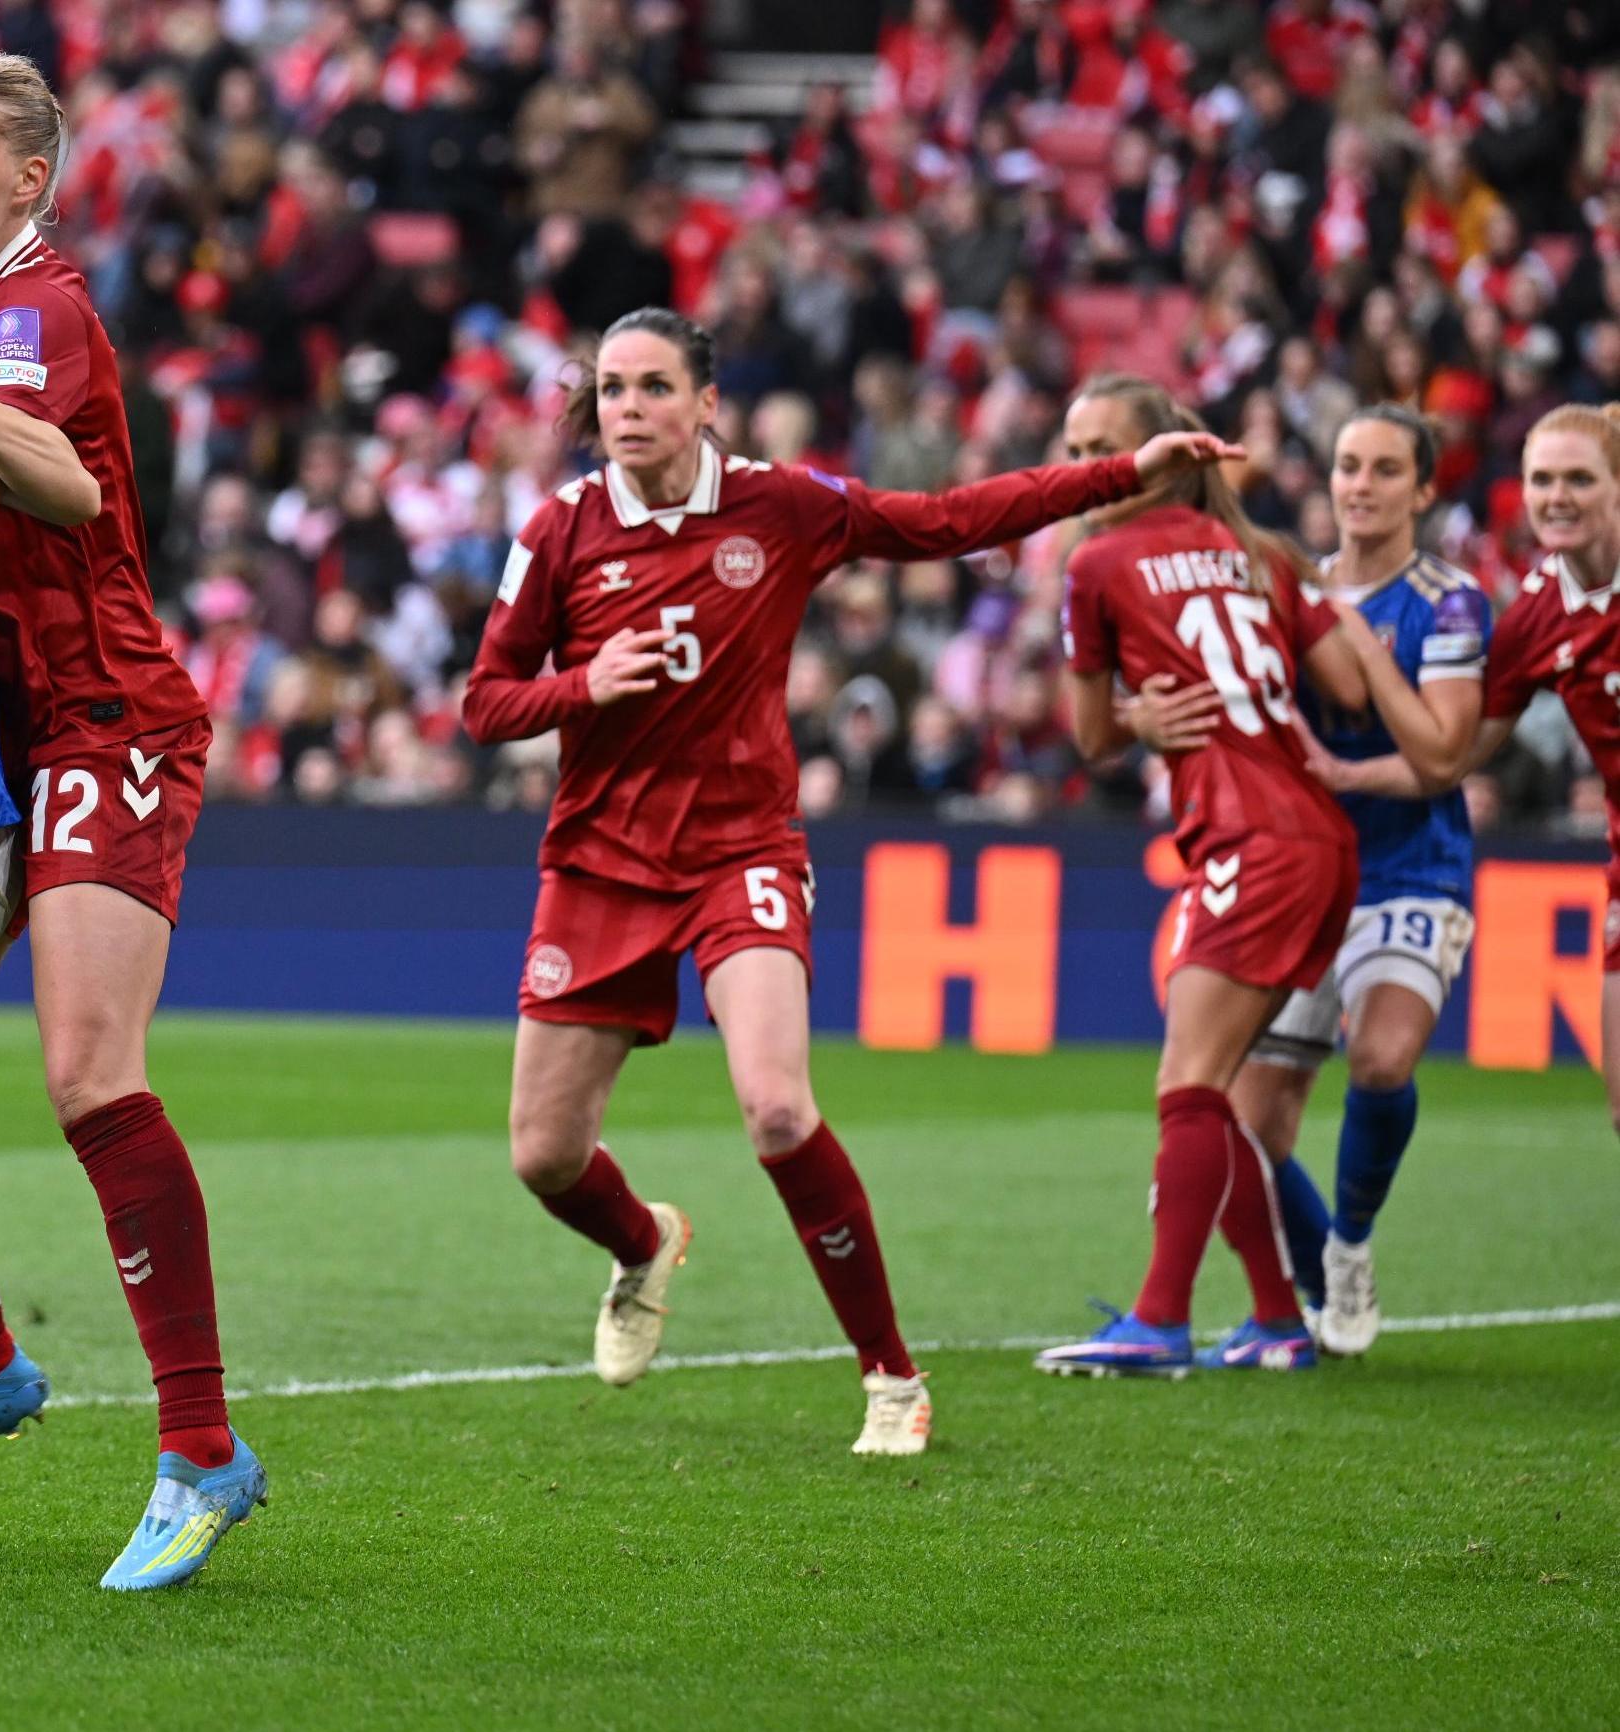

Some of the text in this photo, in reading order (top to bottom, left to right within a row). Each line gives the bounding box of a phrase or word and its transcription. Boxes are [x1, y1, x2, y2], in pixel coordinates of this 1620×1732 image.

[1136, 549, 1268, 596] THØGERS
[659, 603, 703, 683] 5
[1176, 591, 1292, 737] 15
[30, 767, 100, 855] 12
[744, 866, 789, 931] 5
[1378, 908, 1435, 951] 19
